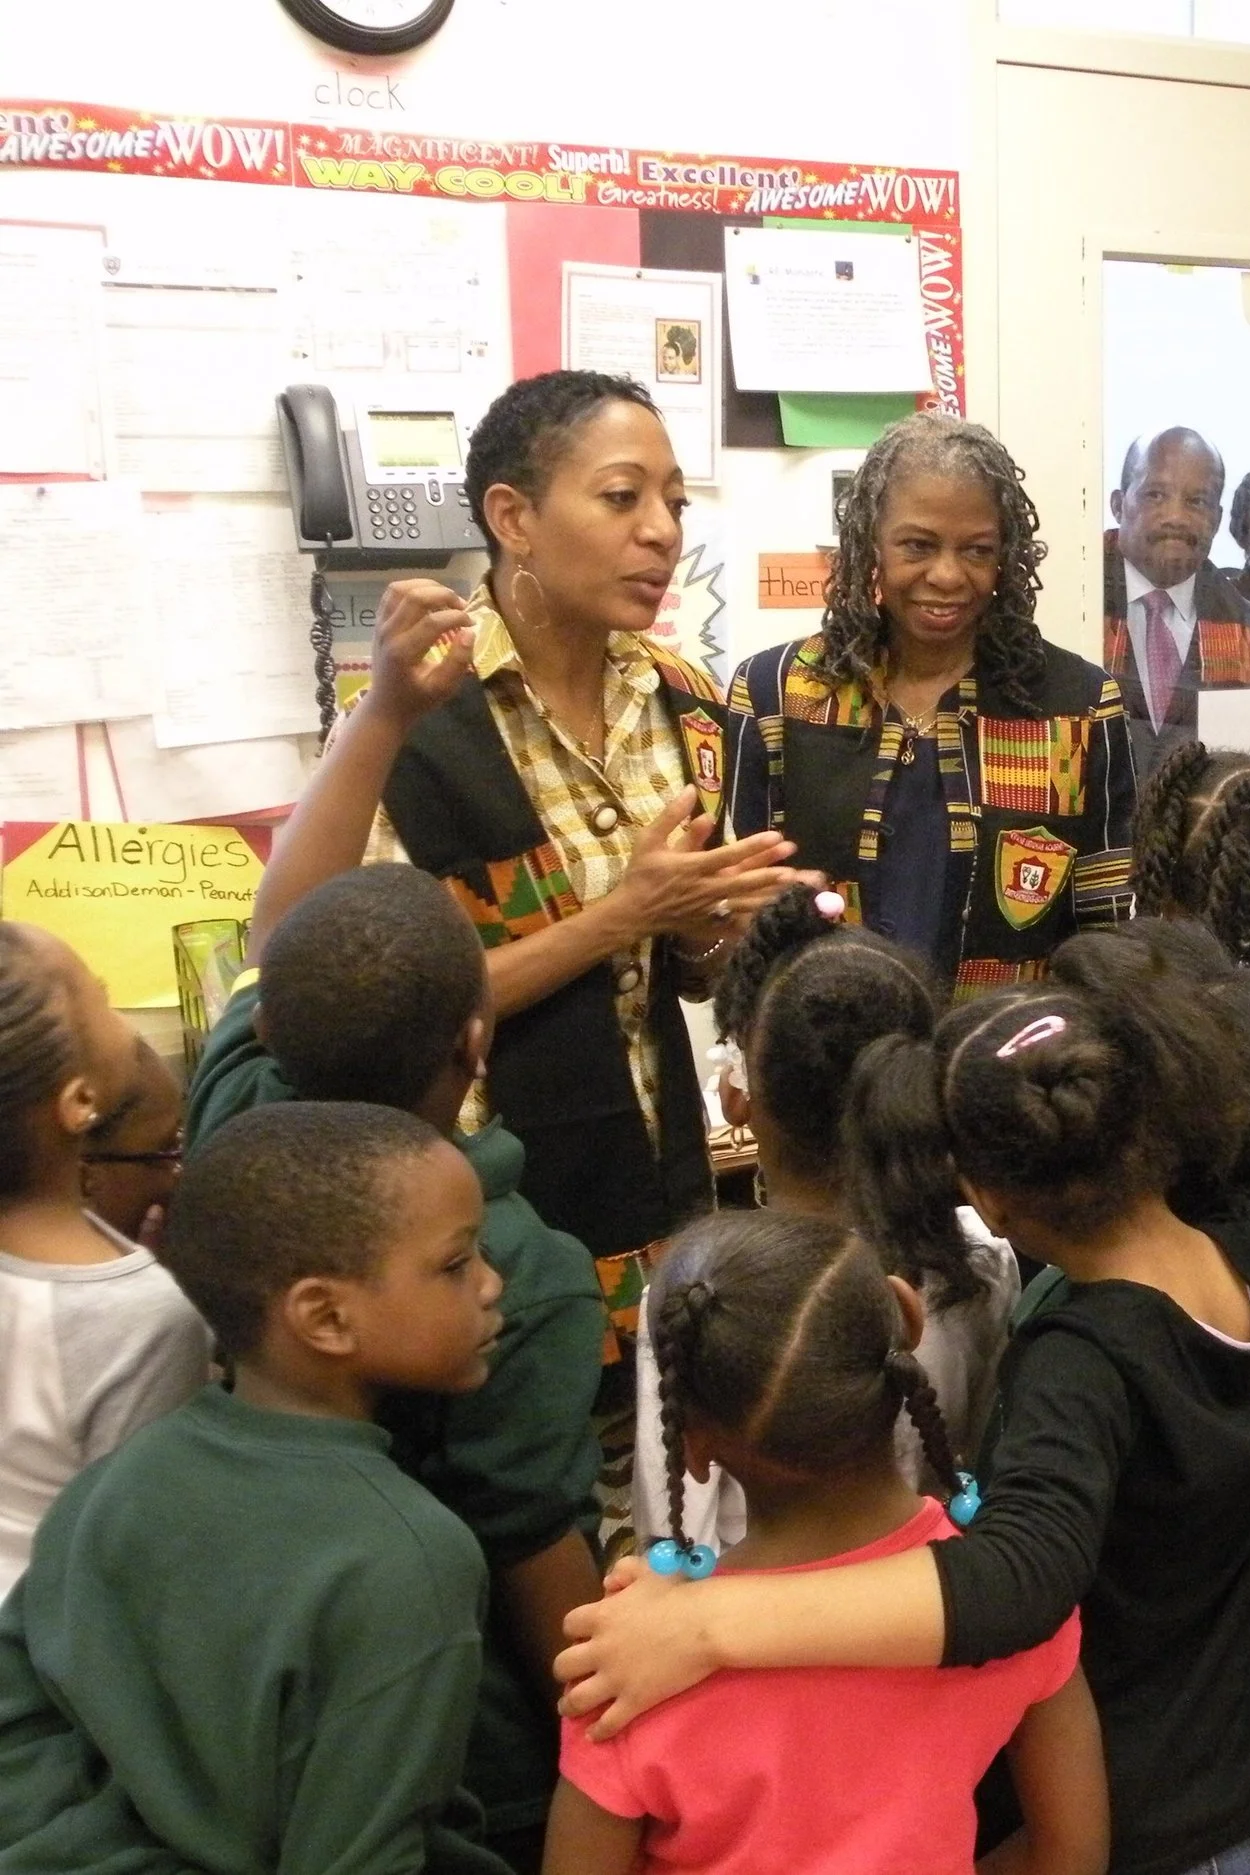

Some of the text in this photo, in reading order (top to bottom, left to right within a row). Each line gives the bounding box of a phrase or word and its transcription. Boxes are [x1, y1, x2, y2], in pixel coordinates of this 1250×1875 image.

[313, 71, 406, 112] clock
[157, 121, 286, 173] WOW!
[338, 130, 630, 176] MAGNIFICENT! Superb!
[302, 156, 587, 204] WAY COOL!
[596, 184, 720, 213] Greatness!
[641, 161, 799, 190] Excellent!
[743, 172, 956, 216] AWESOME! WOW!
[919, 230, 954, 332] WOW!
[48, 822, 250, 884] Allergies
